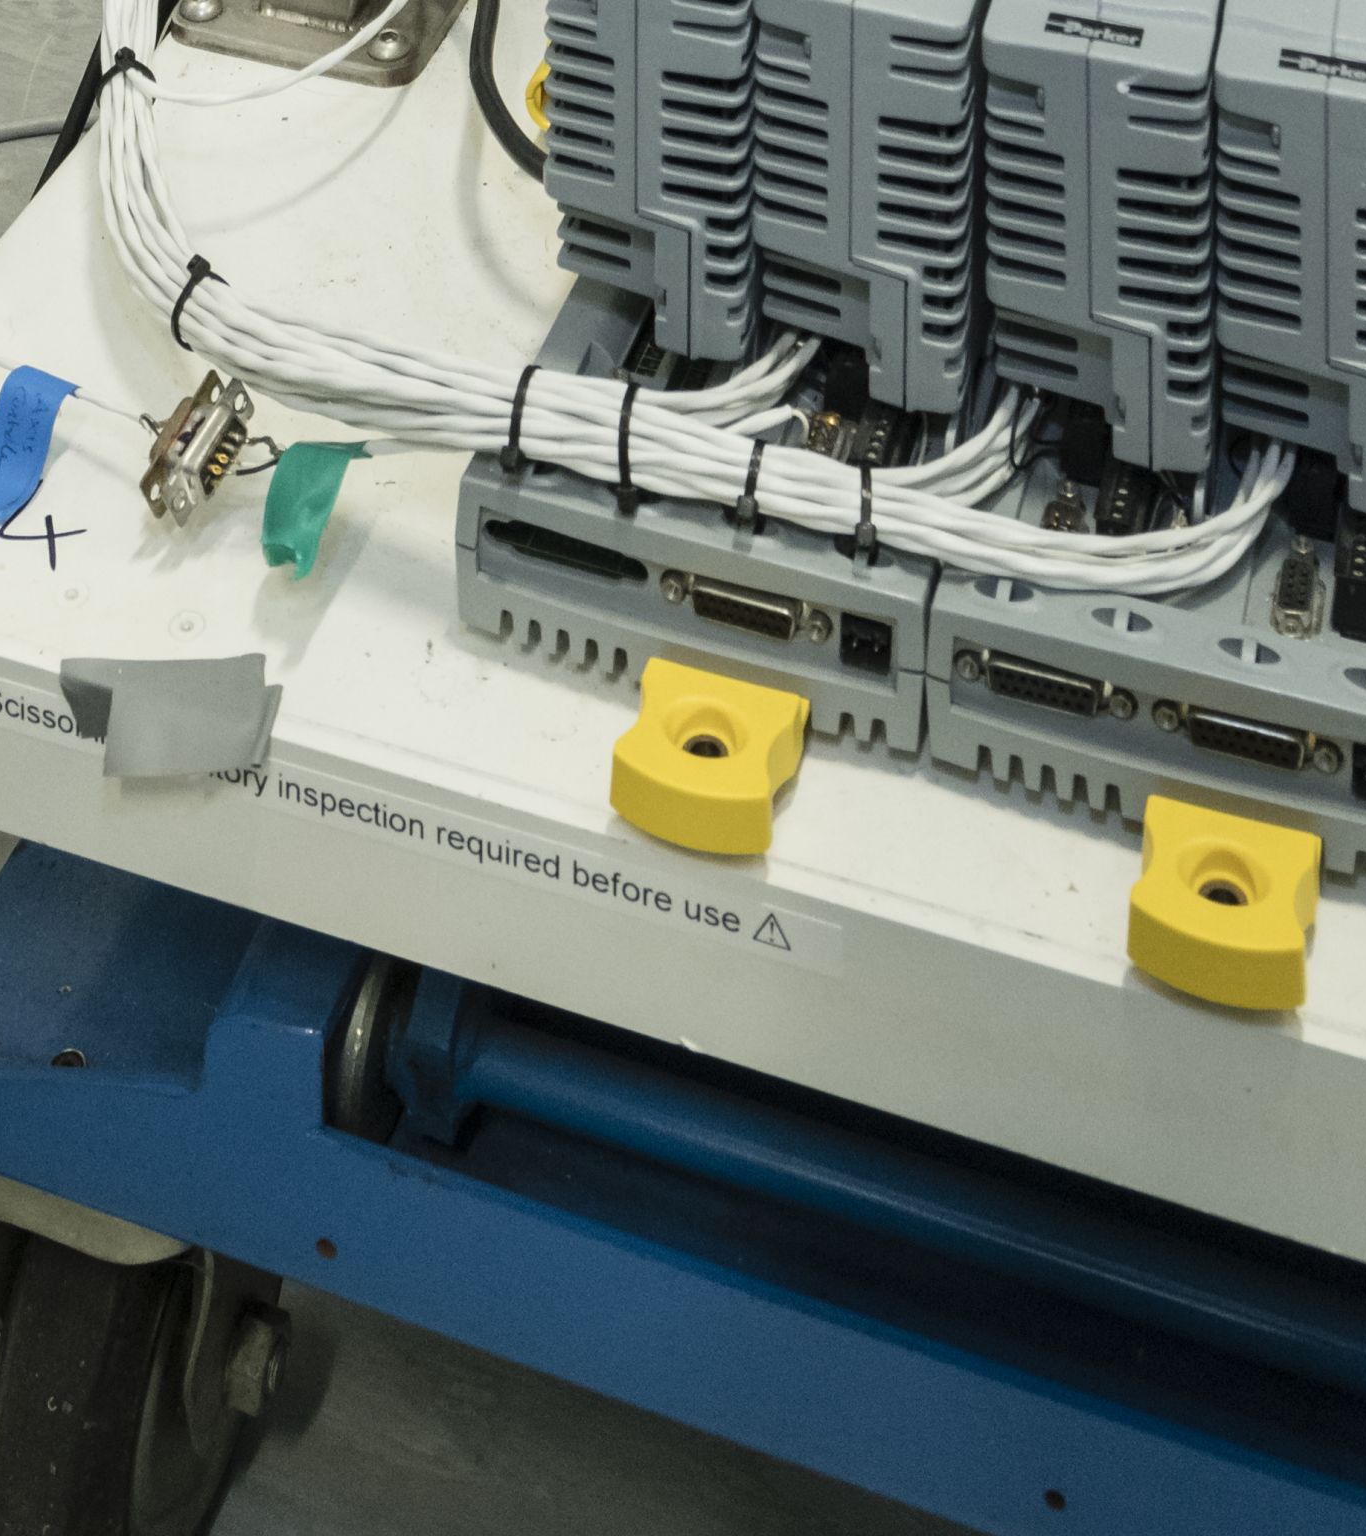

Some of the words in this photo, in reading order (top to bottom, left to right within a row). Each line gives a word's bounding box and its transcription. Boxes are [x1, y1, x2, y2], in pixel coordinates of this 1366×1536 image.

[1063, 18, 1140, 45] Parker
[277, 772, 426, 841] inspection
[435, 824, 561, 881] required
[571, 859, 674, 913] before
[683, 900, 742, 933] use
